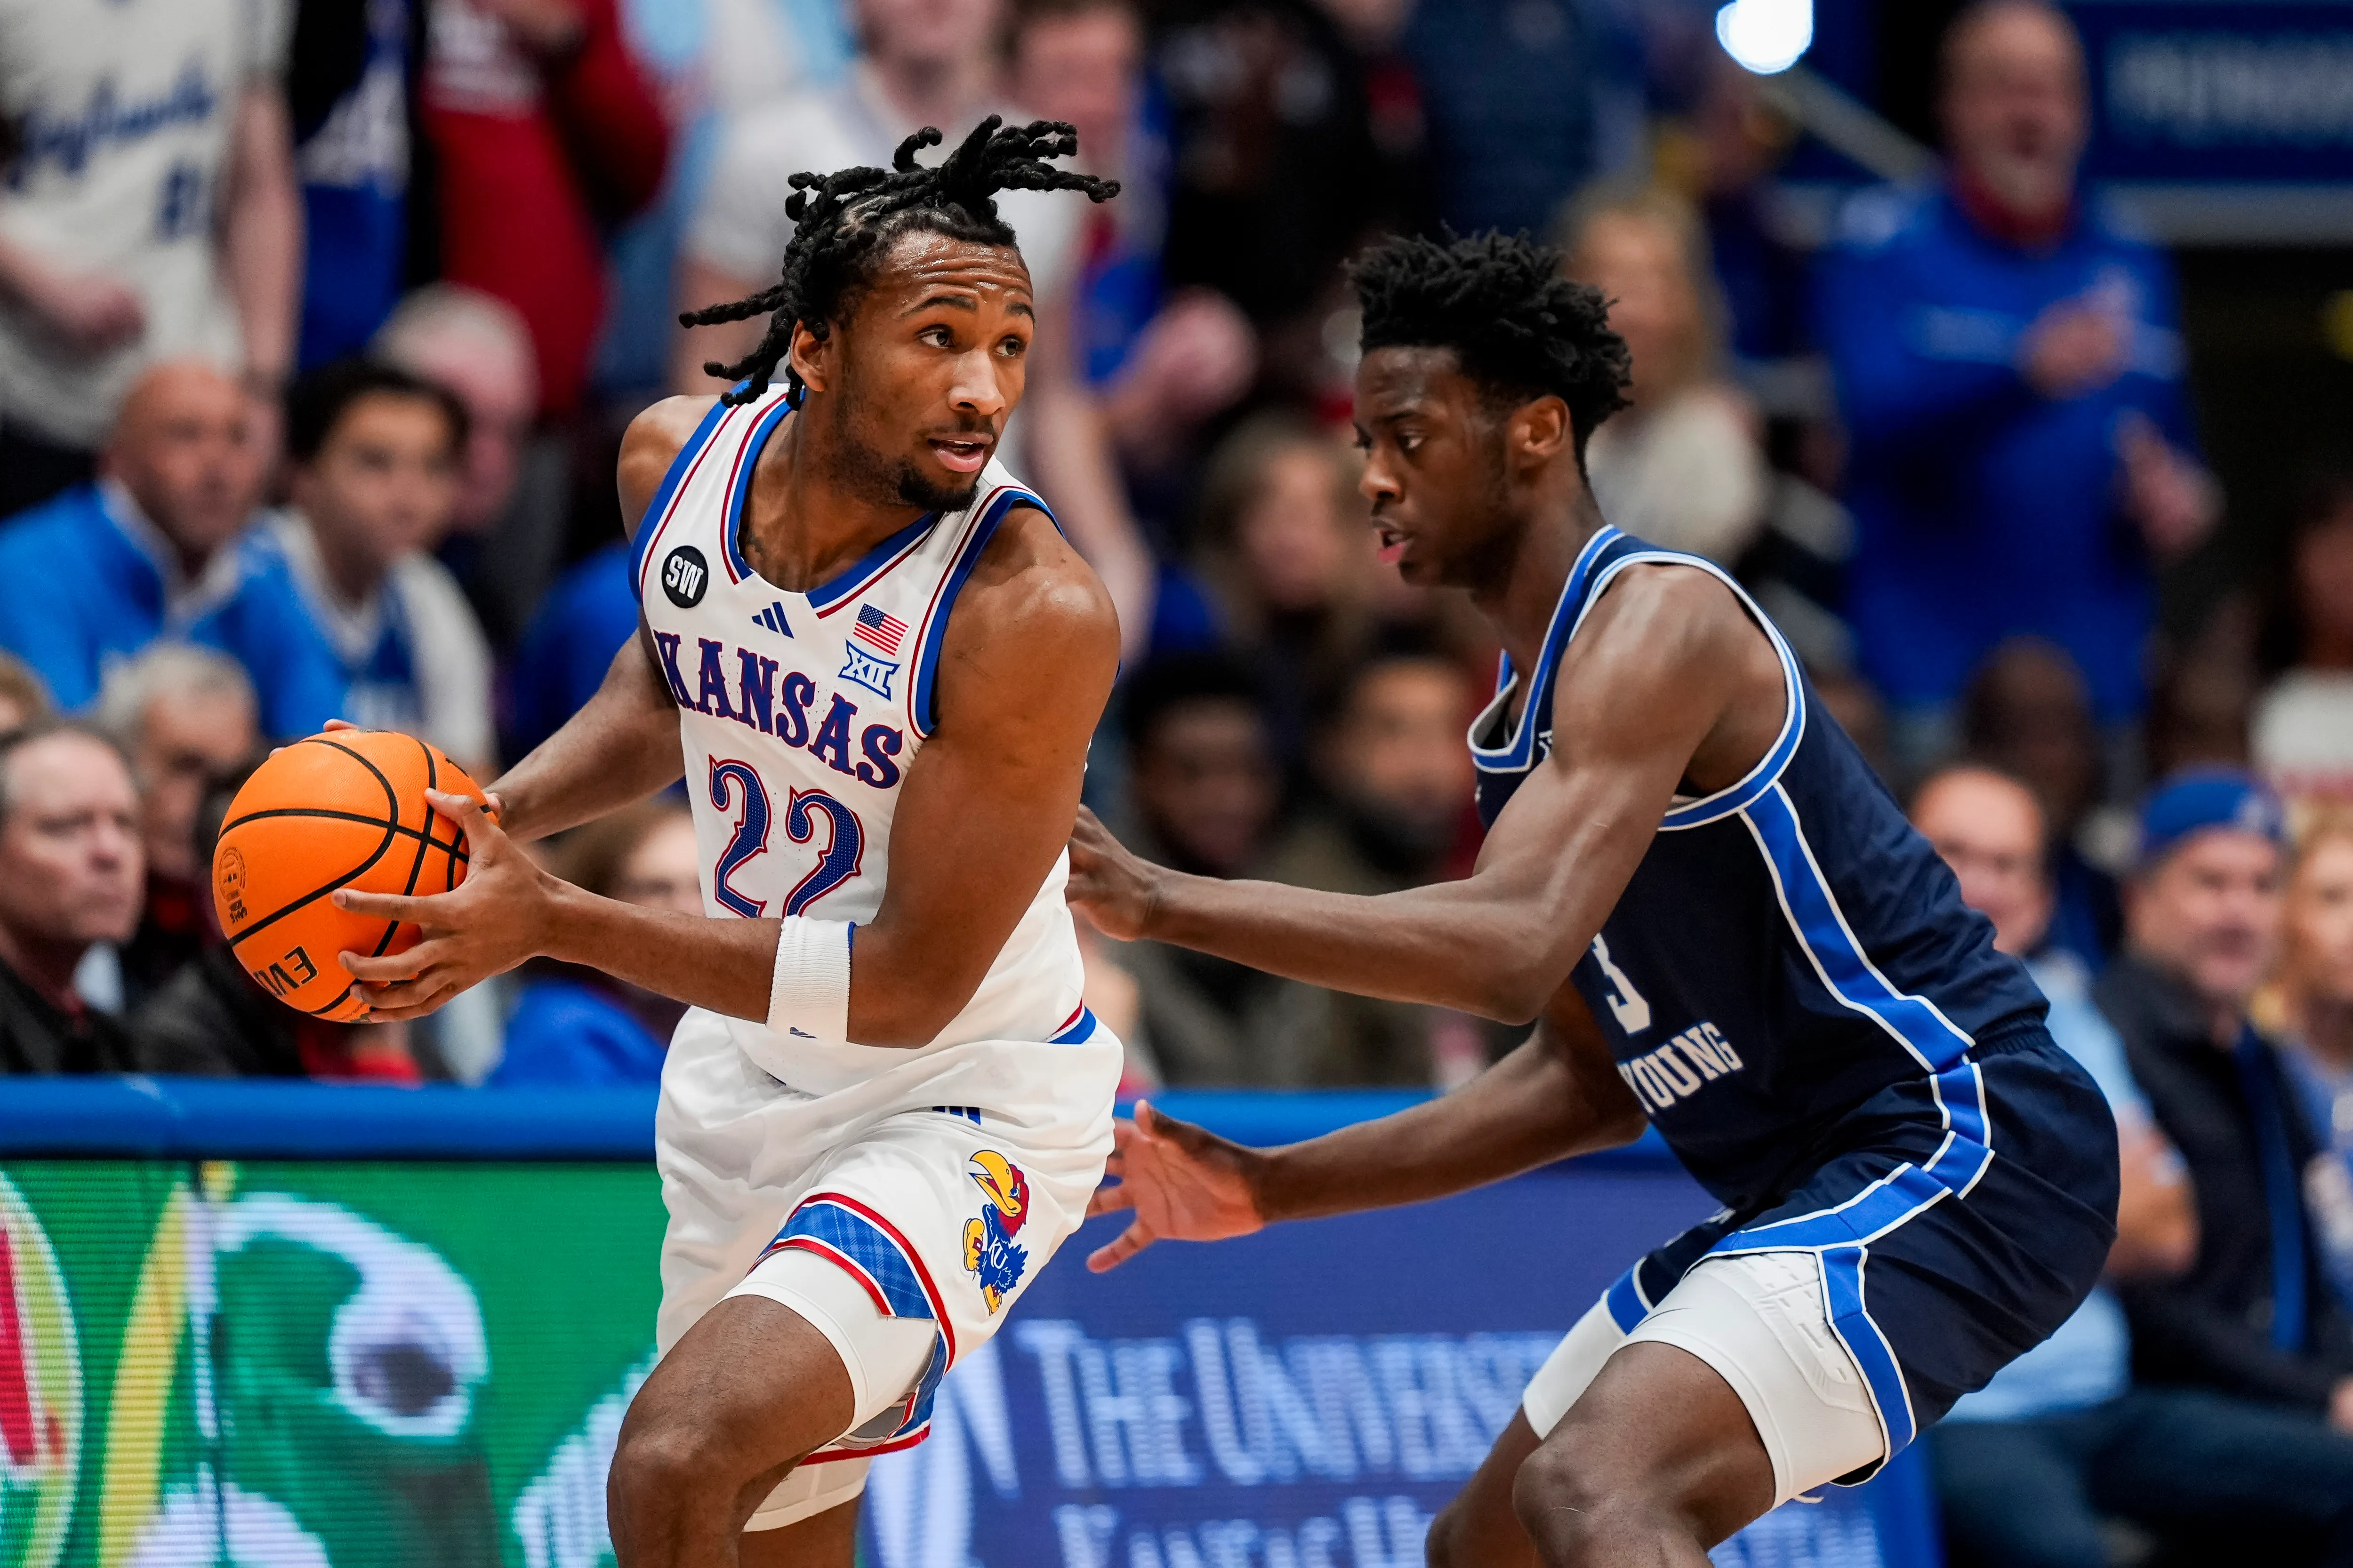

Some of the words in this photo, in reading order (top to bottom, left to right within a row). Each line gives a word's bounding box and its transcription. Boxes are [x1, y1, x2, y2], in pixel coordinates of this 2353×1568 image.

[666, 555, 704, 599] SW
[652, 630, 903, 790] KANSAS
[838, 639, 901, 702] XII
[708, 753, 865, 918] 22
[988, 1234, 1009, 1269] KU
[1012, 1318, 1205, 1487] THE
